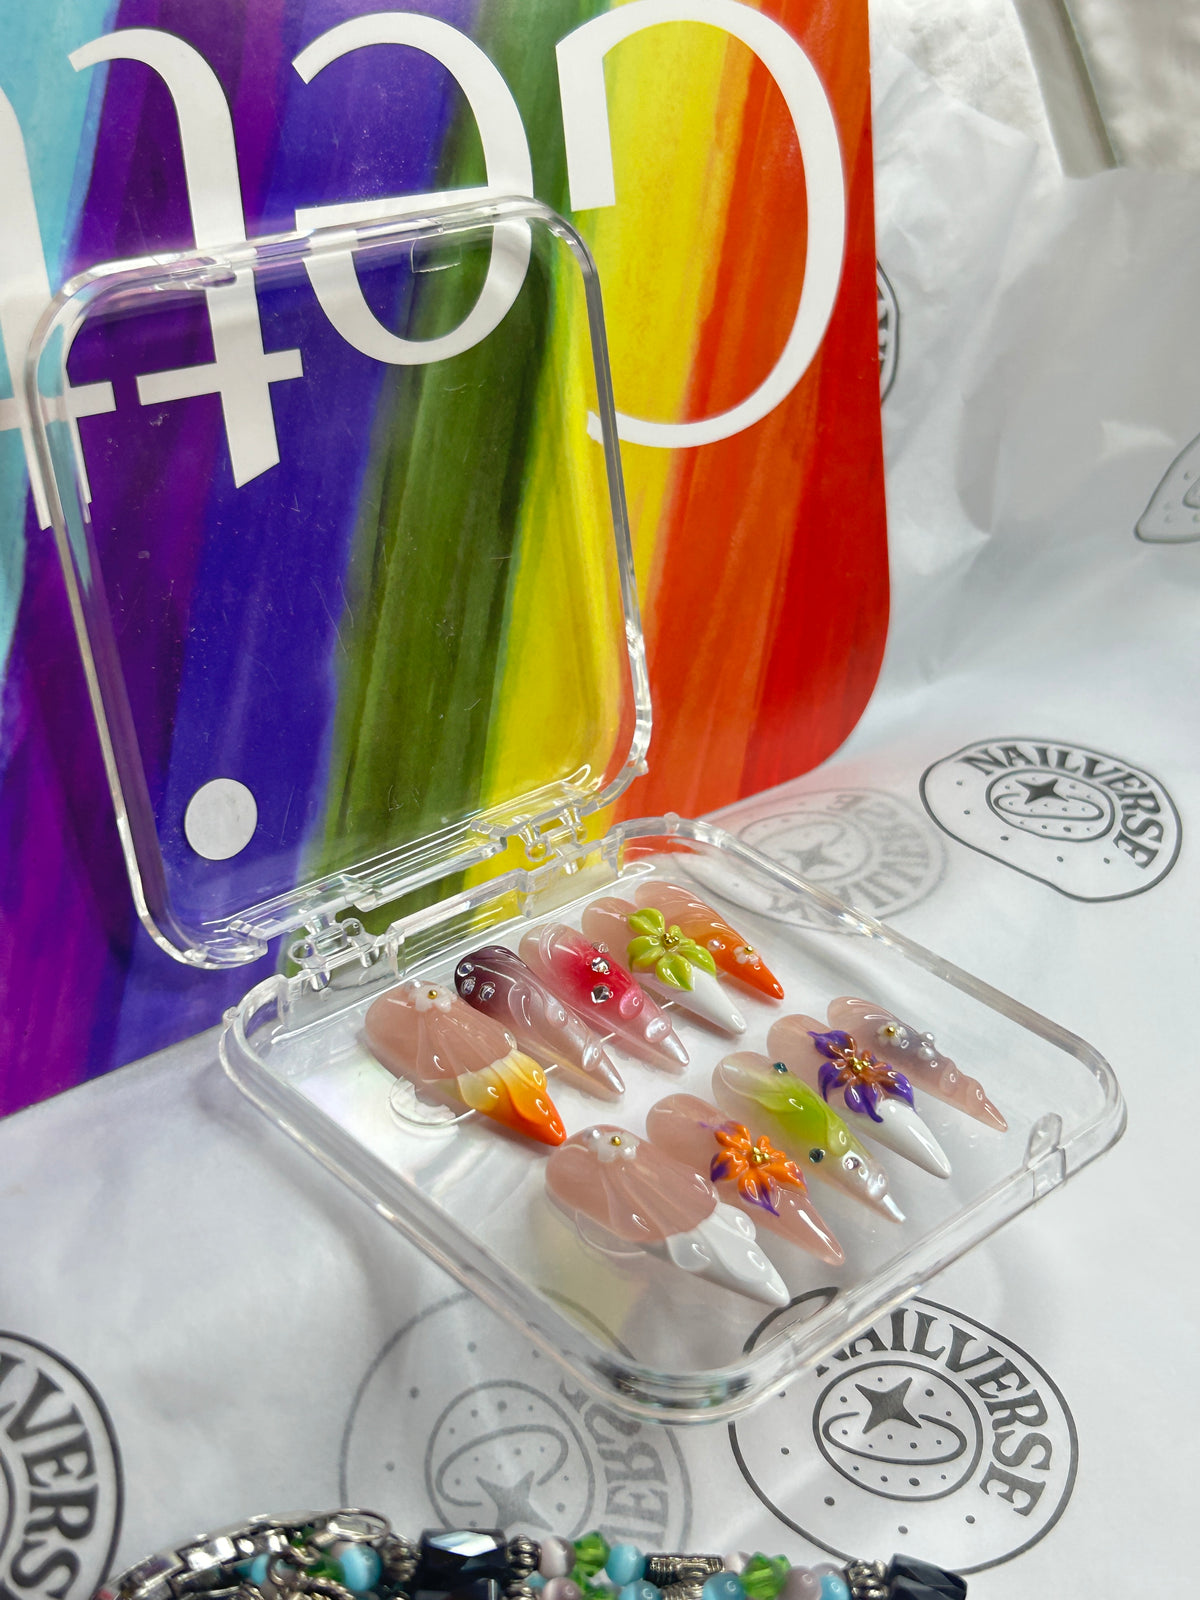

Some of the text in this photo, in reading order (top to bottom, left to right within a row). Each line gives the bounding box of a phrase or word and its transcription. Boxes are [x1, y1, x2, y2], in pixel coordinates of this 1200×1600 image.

[955, 744, 1164, 869] NAILVERSE
[0, 1354, 98, 1600] VERS
[815, 1307, 1053, 1516] AILVERSE
